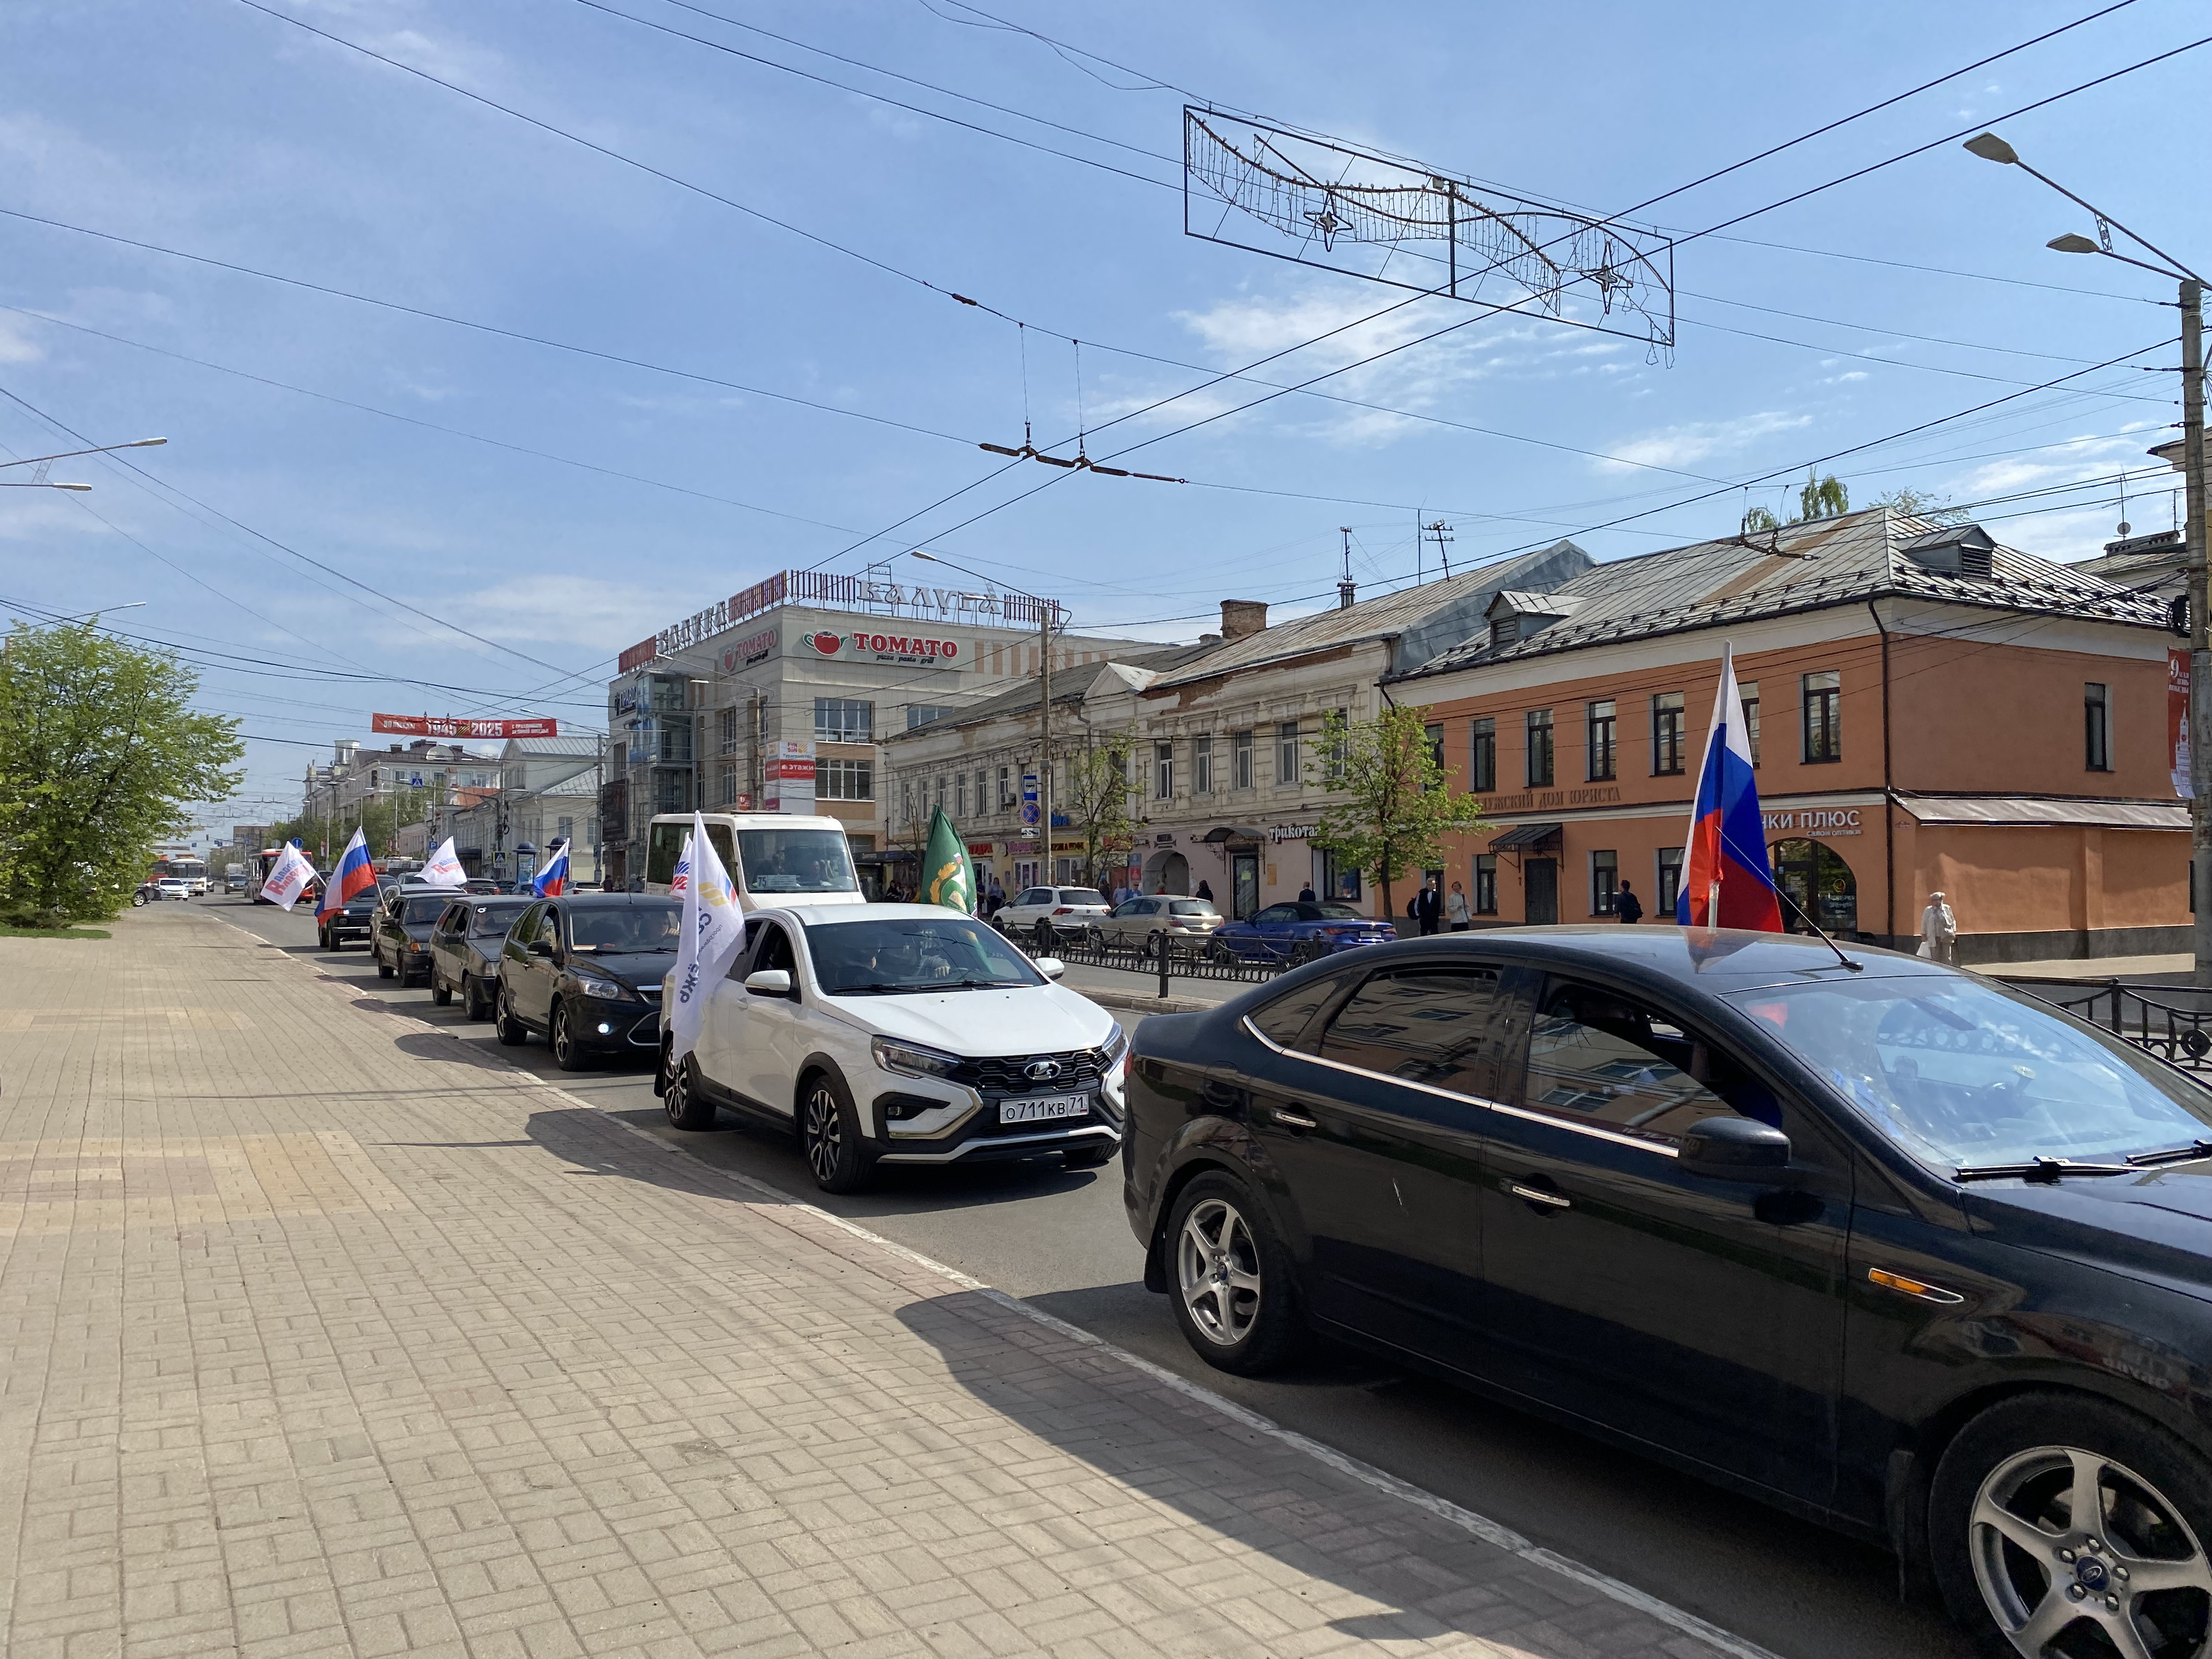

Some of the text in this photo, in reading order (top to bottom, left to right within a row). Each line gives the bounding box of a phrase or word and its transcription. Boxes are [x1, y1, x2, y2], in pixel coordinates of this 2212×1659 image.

[853, 633, 957, 657] TOMATO
[427, 720, 457, 736] 1945
[471, 722, 503, 737] 2025
[1474, 787, 1621, 811] ЛУЖСКИЙ ДОМ ЮРИСТА
[1762, 810, 1860, 830] ЧКИ ПЛЮС
